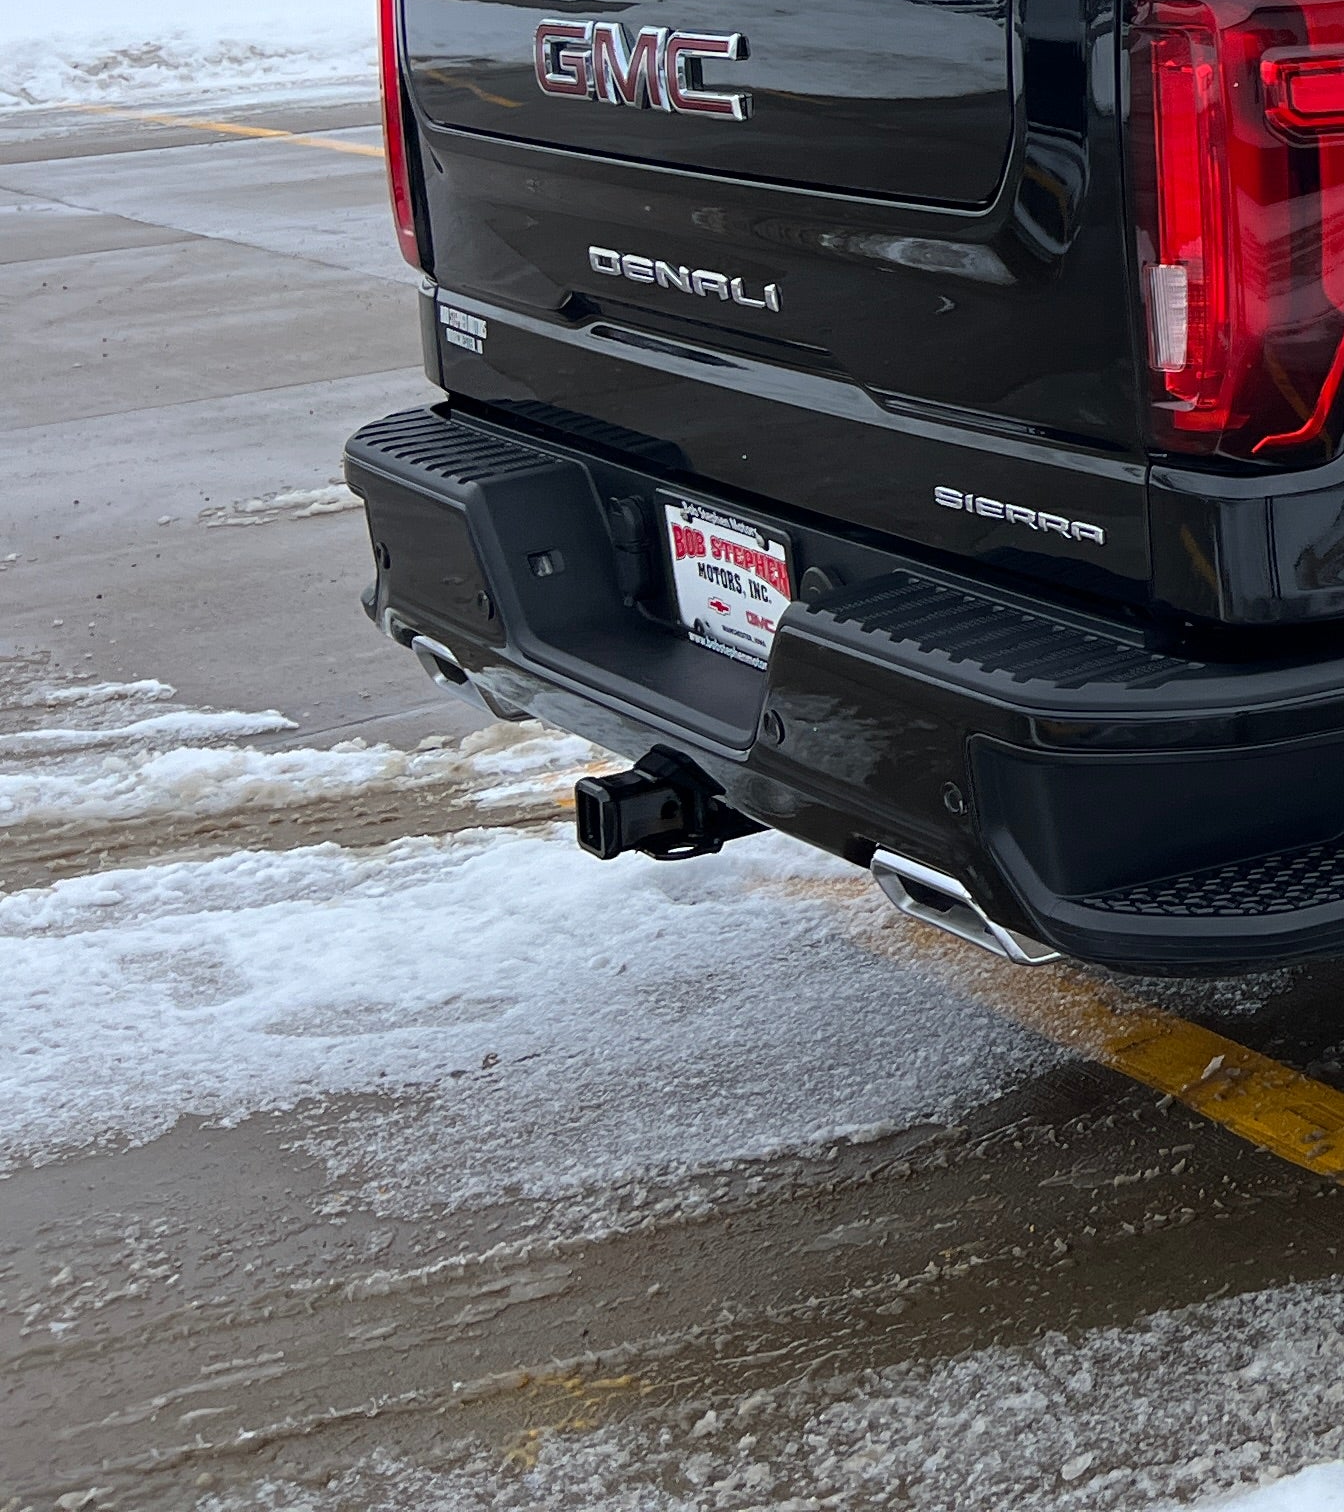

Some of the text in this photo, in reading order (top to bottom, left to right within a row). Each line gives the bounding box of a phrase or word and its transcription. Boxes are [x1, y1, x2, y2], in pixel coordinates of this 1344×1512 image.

[534, 18, 754, 122] GMC
[588, 244, 783, 313] DENALI
[698, 506, 731, 528] Stephen
[729, 517, 757, 536] Motors
[934, 486, 1104, 546] SIERRA
[672, 522, 792, 601] BOB STEPHEN
[697, 562, 773, 604] MOTORS, INC.
[746, 610, 777, 634] GMC
